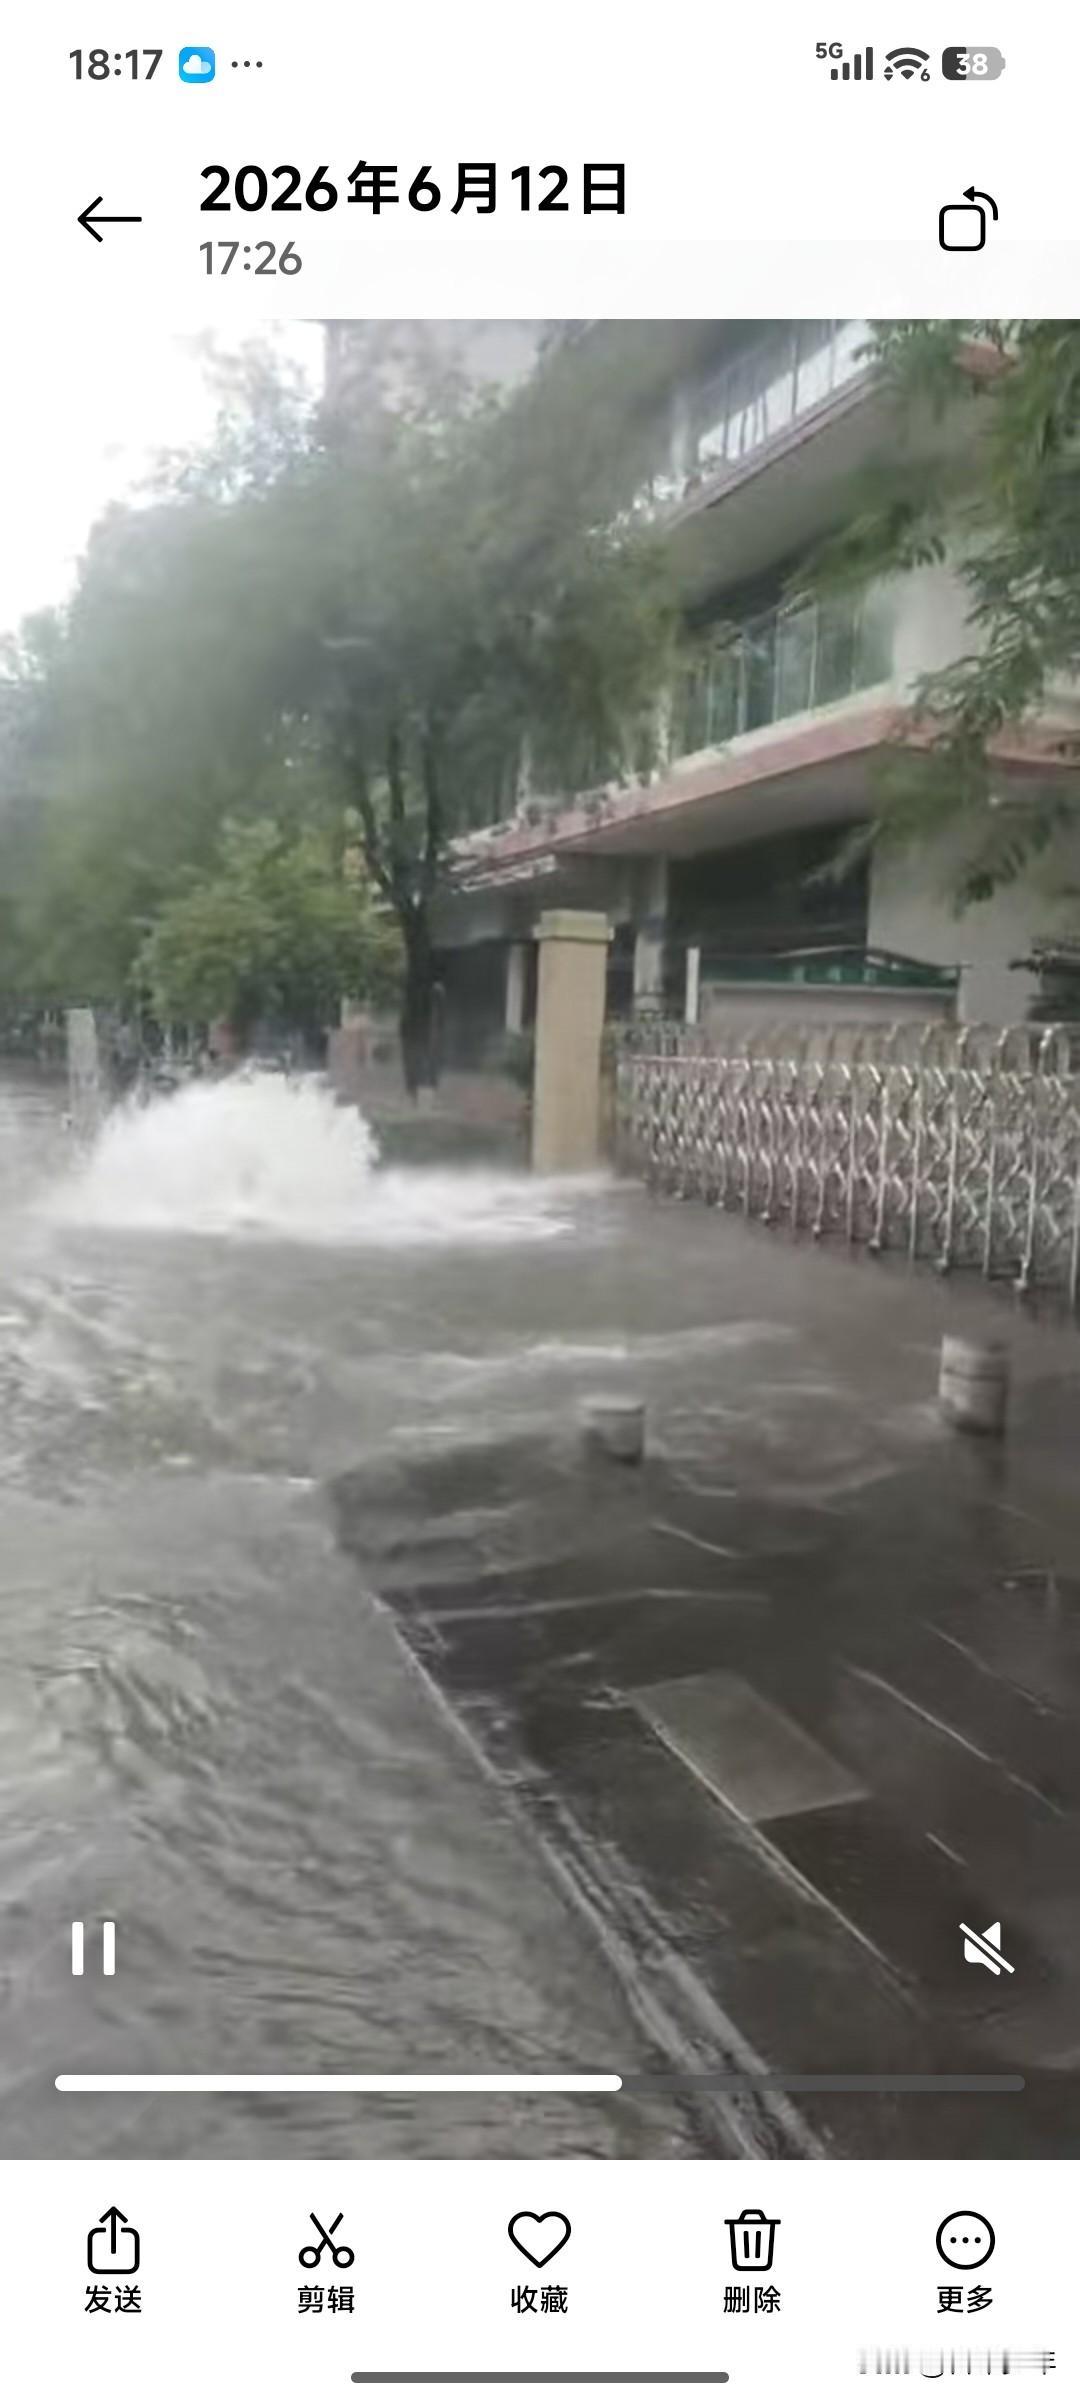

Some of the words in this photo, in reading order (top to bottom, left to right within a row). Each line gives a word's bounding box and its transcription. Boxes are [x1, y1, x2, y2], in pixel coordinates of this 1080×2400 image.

[70, 49, 162, 80] 18:17
[816, 43, 843, 59] 5G
[956, 53, 988, 76] 38
[921, 68, 931, 82] 6
[201, 160, 624, 214] 2026年6月12日
[200, 241, 302, 275] 17:26
[84, 2285, 141, 2314] 发送
[297, 2285, 355, 2314] 剪辑
[510, 2285, 568, 2314] 收藏
[723, 2285, 781, 2314] 删除
[936, 2285, 993, 2314] 更多
